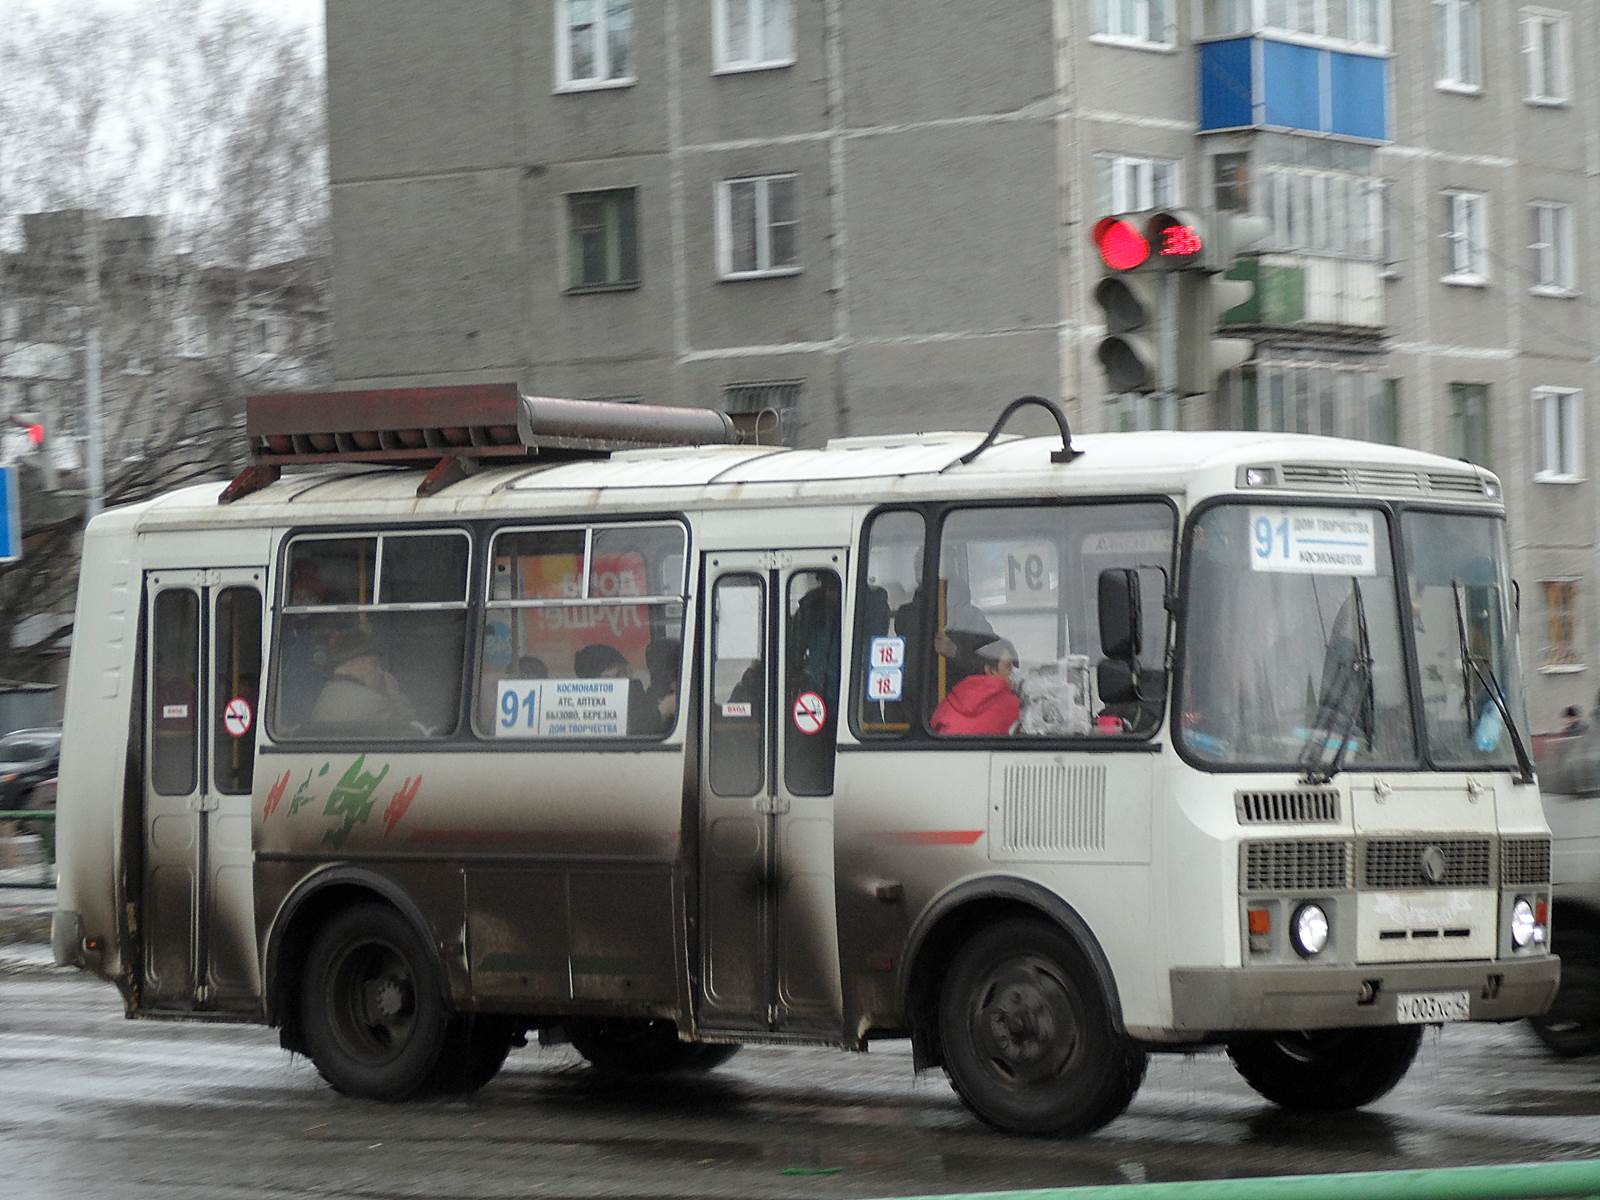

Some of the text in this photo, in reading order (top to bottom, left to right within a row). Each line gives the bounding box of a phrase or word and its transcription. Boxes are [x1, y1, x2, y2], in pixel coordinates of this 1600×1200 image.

[1294, 517, 1369, 534] ДОМ ТВОРЧЕСТВА
[1255, 516, 1289, 558] 91
[880, 646, 893, 663] 18
[556, 682, 613, 694] КОСМОНАВТОВ
[877, 678, 891, 694] 18
[501, 689, 536, 729] 91
[577, 697, 606, 707] АПТЕКА
[583, 710, 617, 720] БЕРЕЗКА
[548, 723, 618, 735] ДОМ ТВОРЧЕСТВА
